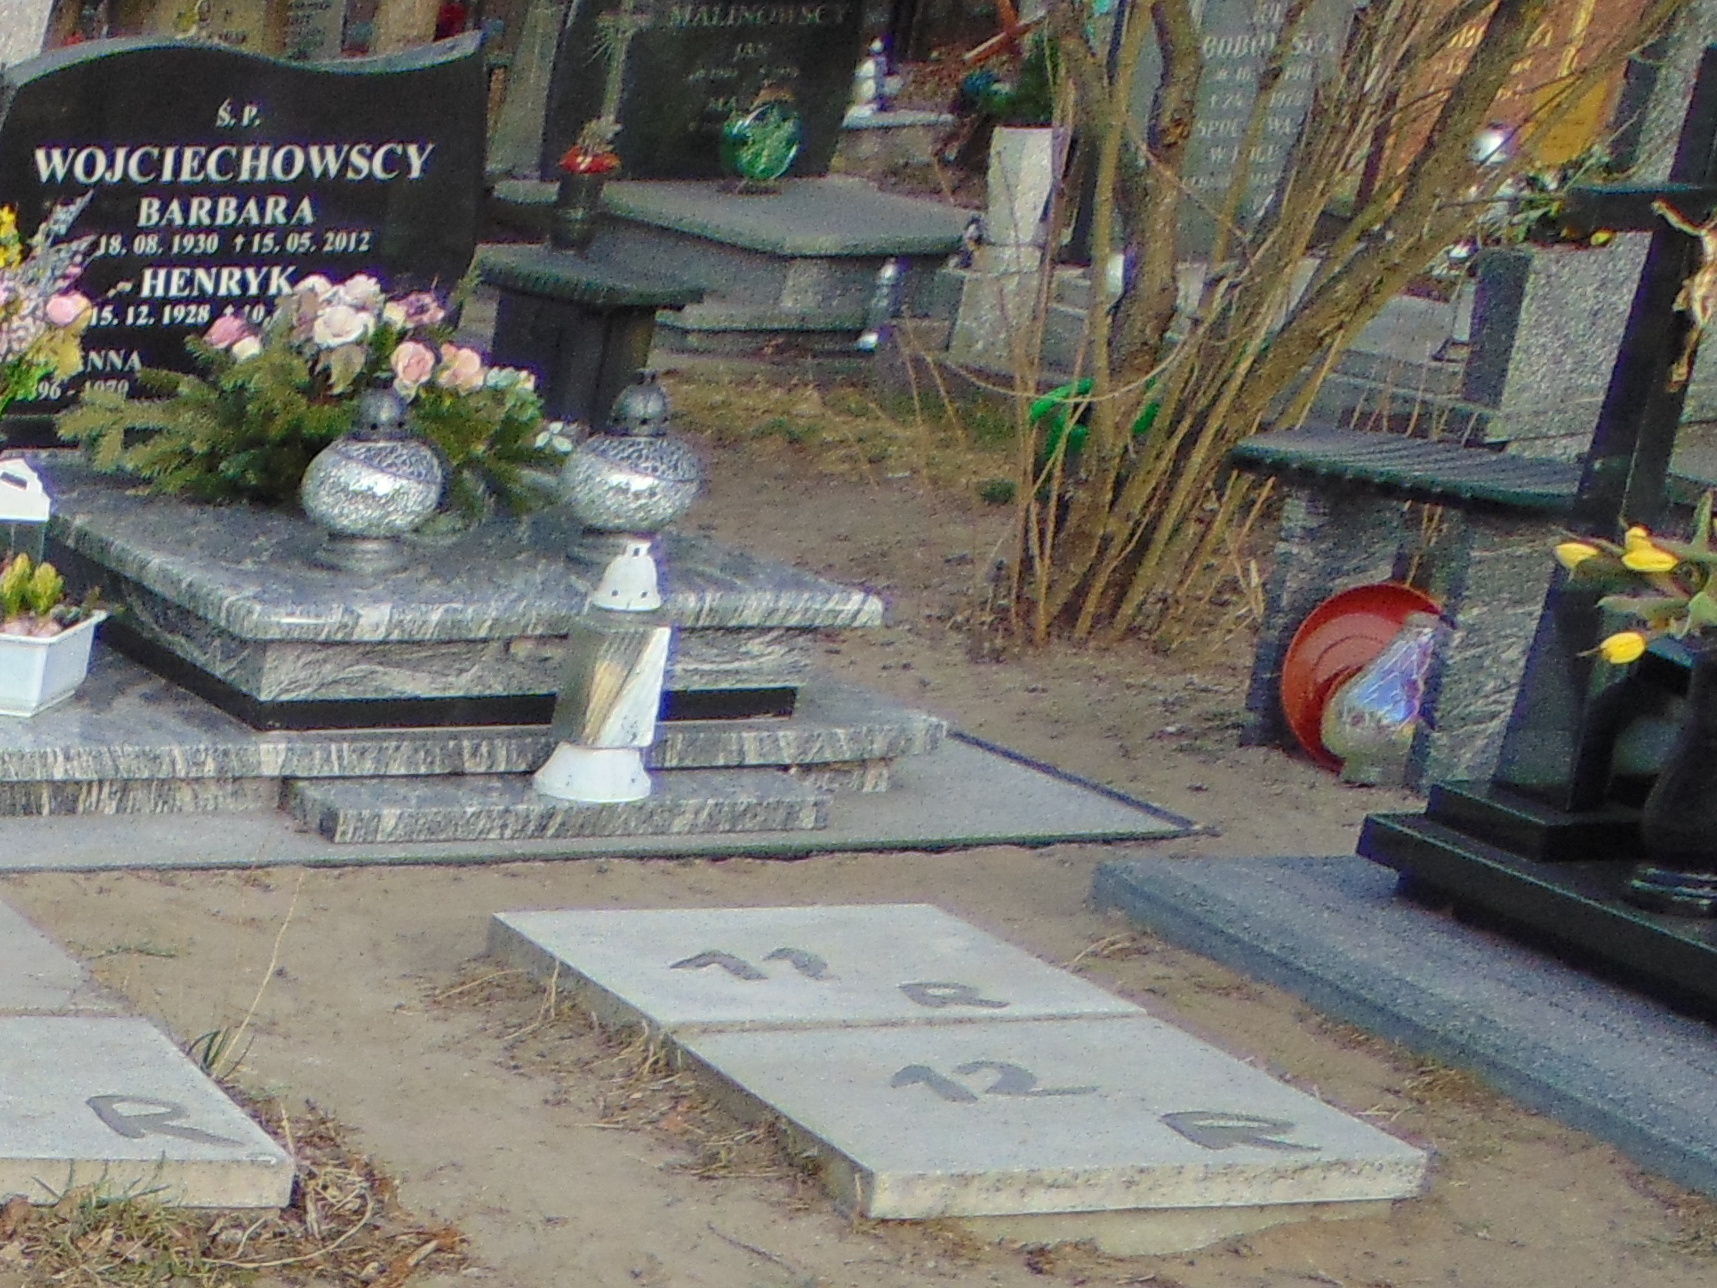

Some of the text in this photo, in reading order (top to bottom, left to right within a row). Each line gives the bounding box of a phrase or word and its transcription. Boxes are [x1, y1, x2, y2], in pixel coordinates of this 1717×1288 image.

[34, 143, 435, 186] WOJCIECHOWSCY
[137, 195, 315, 228] BARBARA
[171, 234, 219, 255] 1930
[323, 231, 371, 252] 2012
[140, 265, 296, 298] HENRYK
[162, 303, 211, 325] 1928
[889, 1058, 1100, 1104] 12
[85, 1094, 247, 1149] R
[1159, 1108, 1325, 1154] R
